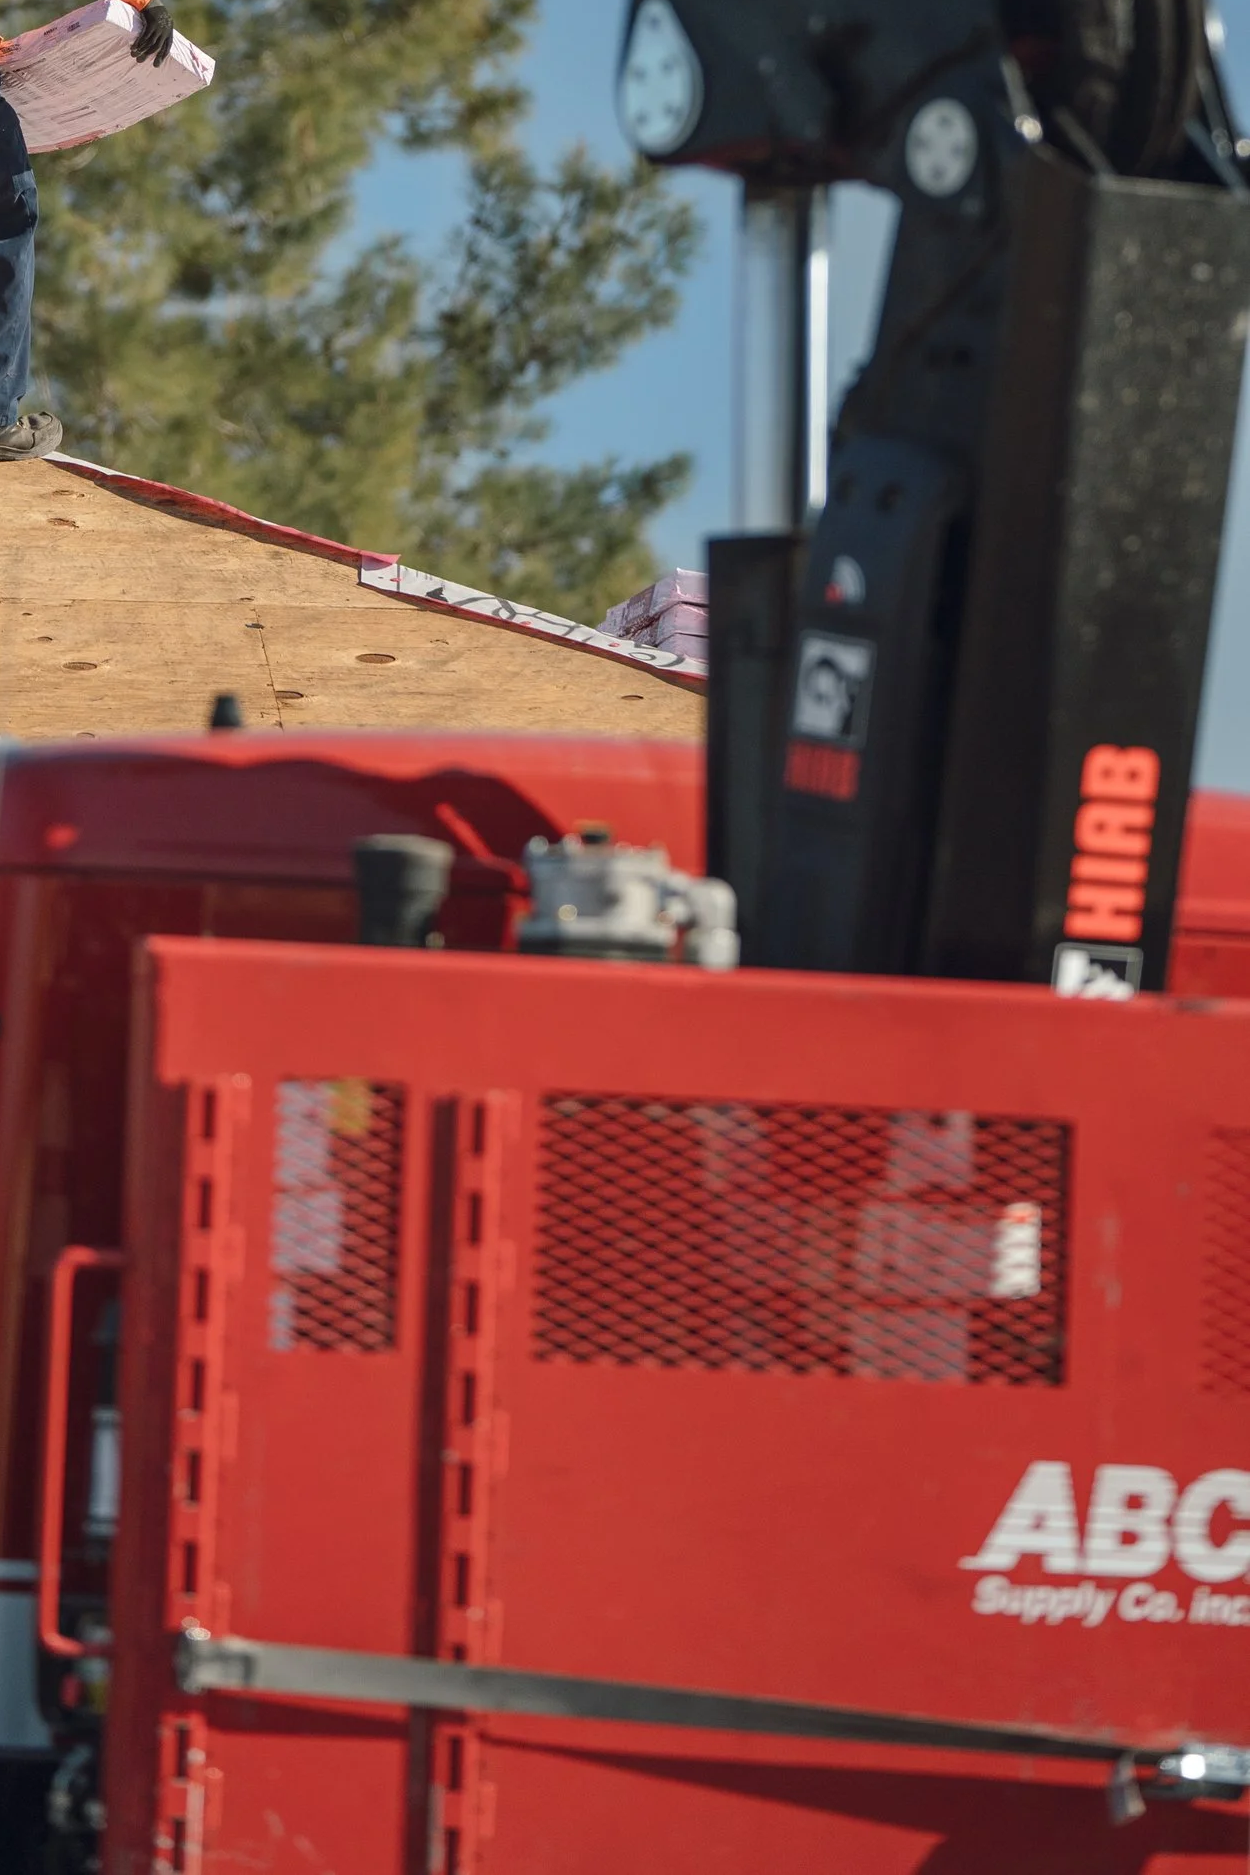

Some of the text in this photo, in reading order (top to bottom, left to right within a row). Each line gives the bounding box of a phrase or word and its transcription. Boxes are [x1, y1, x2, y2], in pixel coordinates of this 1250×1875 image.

[1062, 743, 1161, 943] HIAB
[957, 1460, 1250, 1584] ABC
[970, 1574, 1118, 1628] Supply
[1116, 1581, 1186, 1623] Co.
